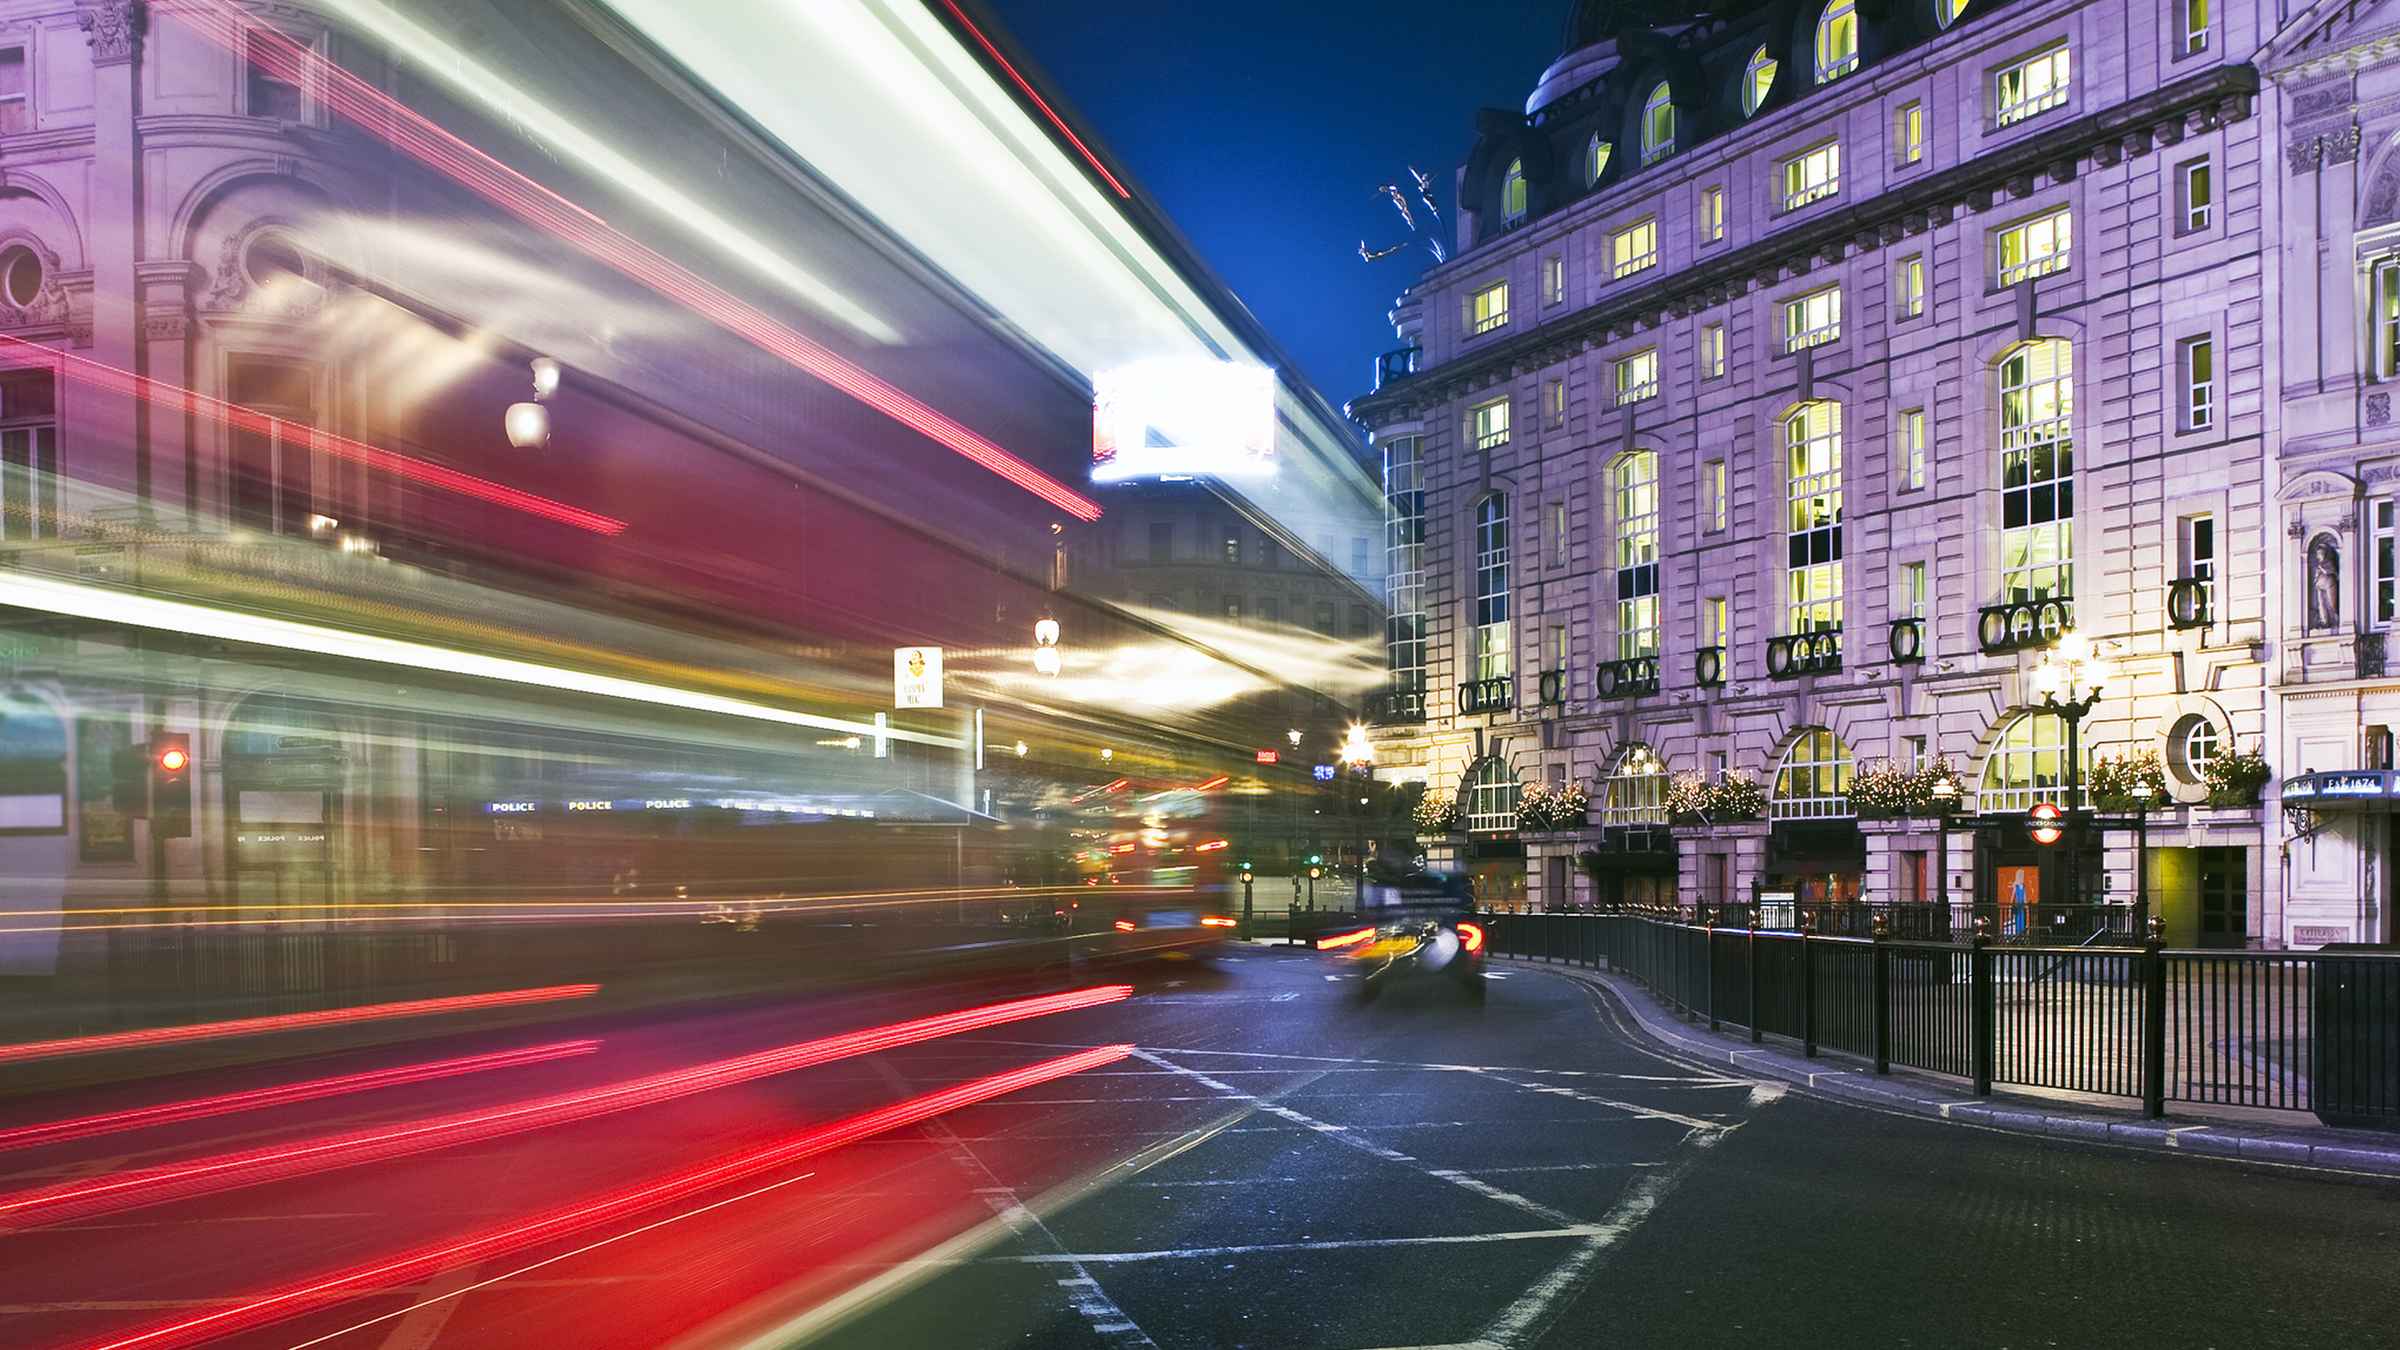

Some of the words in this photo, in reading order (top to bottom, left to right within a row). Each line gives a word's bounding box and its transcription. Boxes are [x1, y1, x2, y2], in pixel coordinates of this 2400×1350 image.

[492, 802, 535, 812] POLICE
[569, 801, 612, 811] POLICE
[645, 800, 690, 809] POLICE
